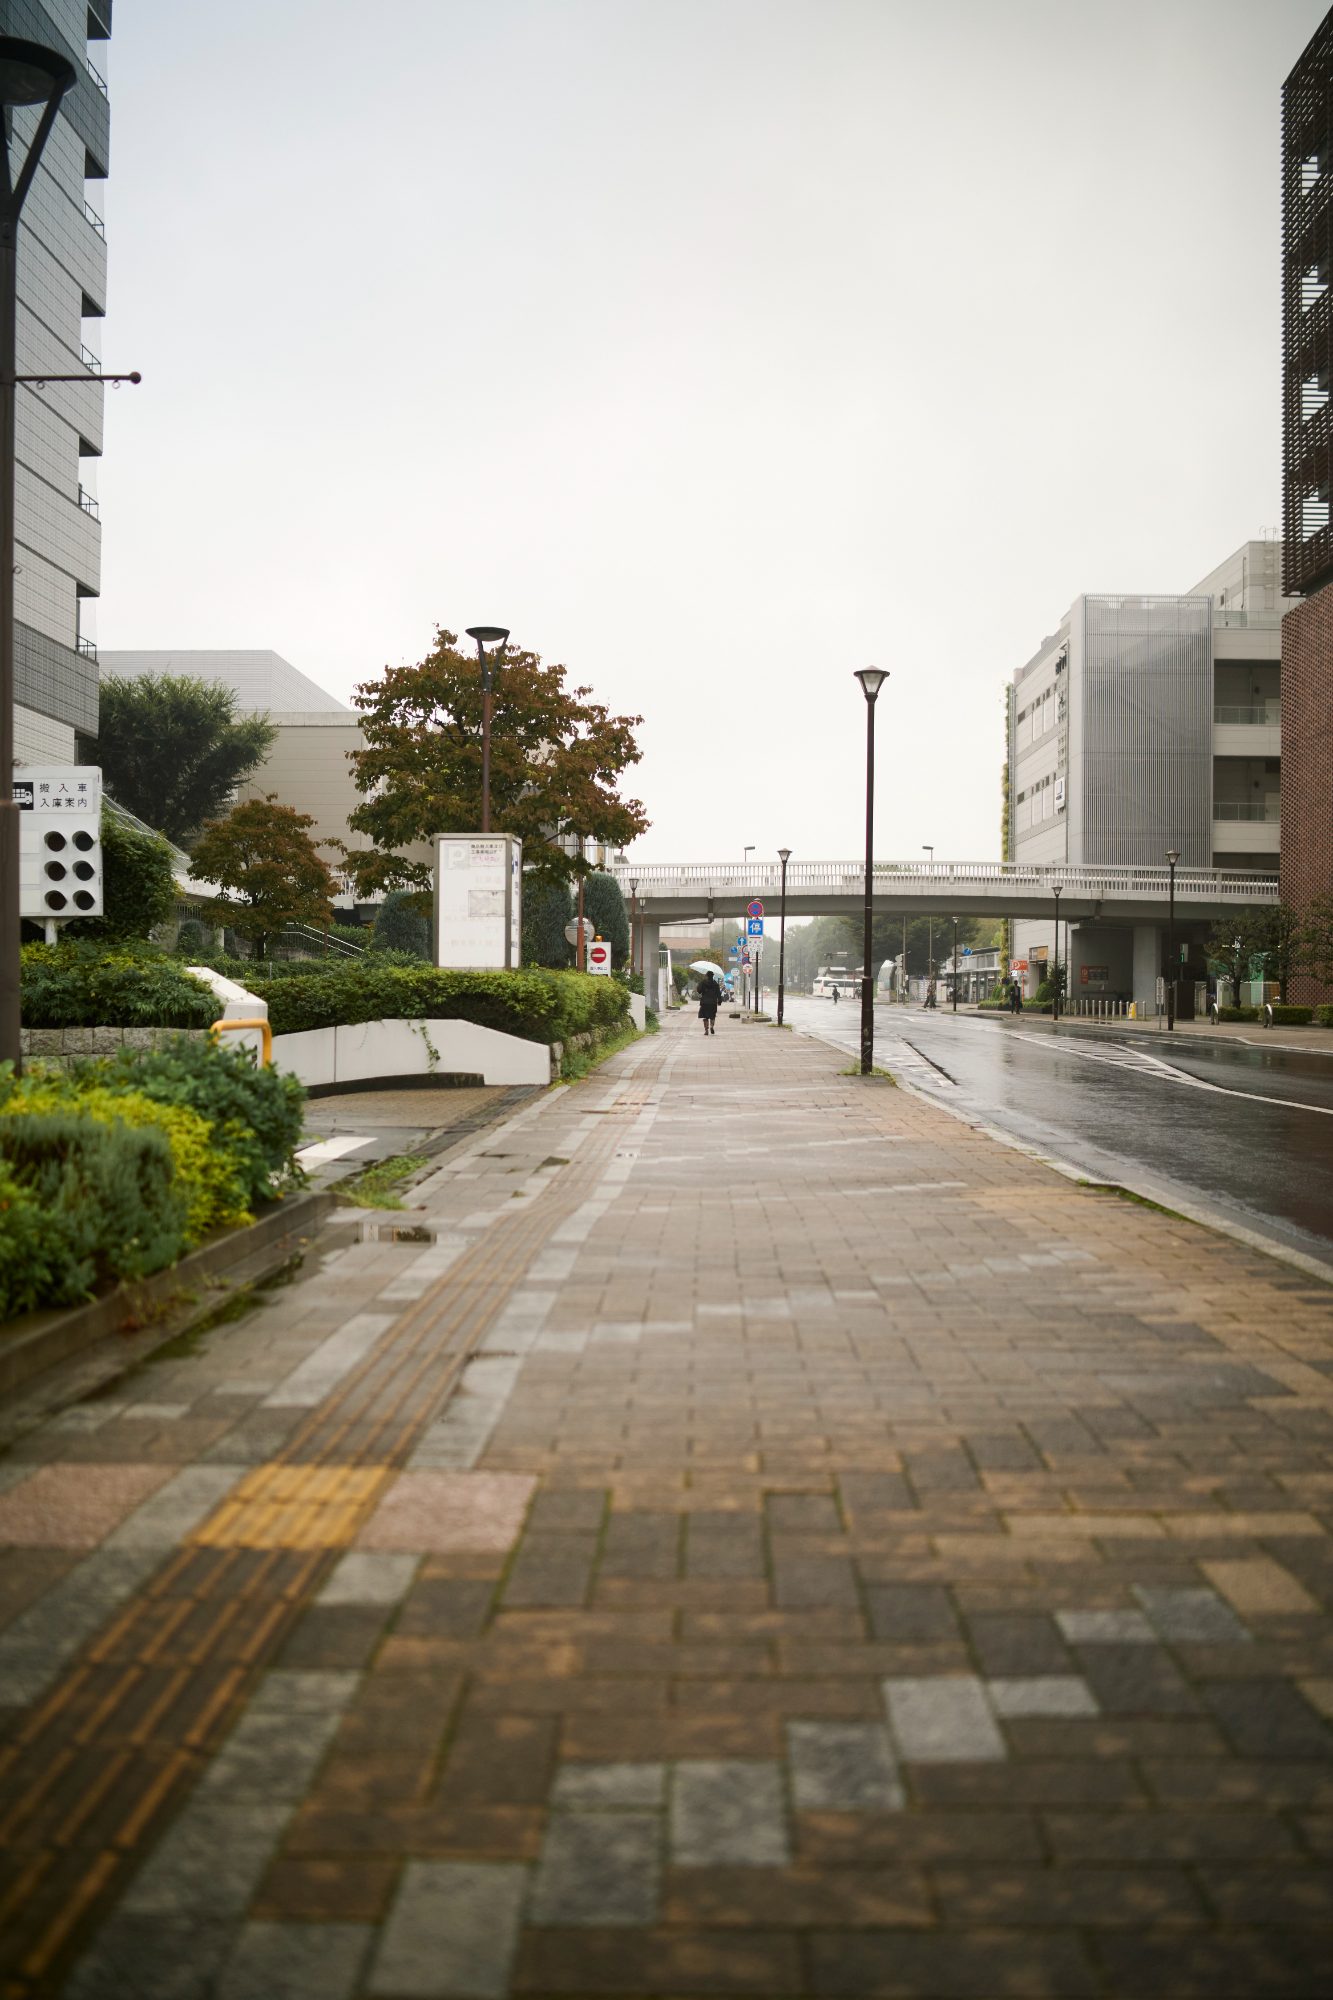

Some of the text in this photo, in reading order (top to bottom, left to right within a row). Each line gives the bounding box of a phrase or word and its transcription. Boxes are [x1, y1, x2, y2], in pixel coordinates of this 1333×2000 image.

[39, 783, 87, 793] 搬入車
[40, 798, 87, 808] 入庫案内
